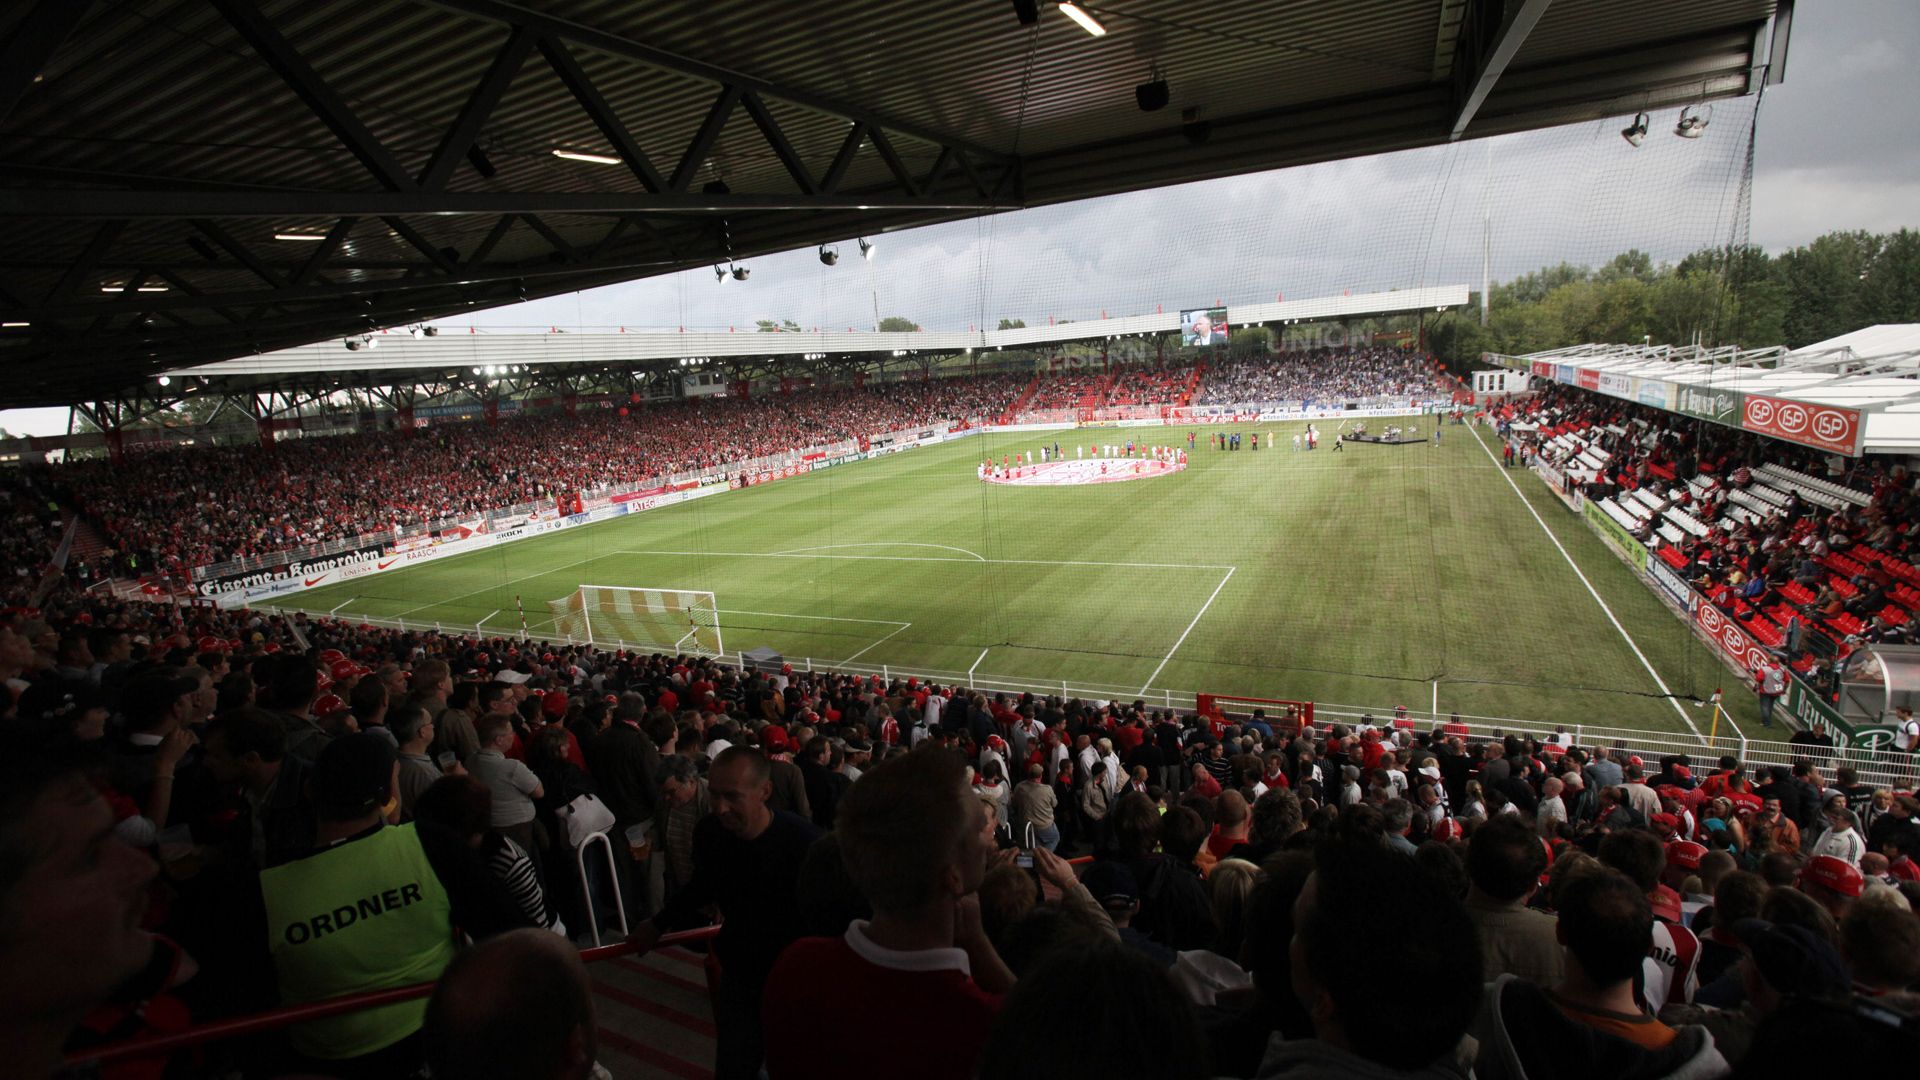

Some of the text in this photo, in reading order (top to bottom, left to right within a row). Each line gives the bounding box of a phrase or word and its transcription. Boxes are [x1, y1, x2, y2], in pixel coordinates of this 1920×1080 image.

[1267, 325, 1374, 353] UNION
[1048, 343, 1147, 371] EISERN
[1751, 403, 1770, 420] ISP
[1782, 409, 1804, 428] ISP
[1818, 415, 1844, 436] ISP
[501, 528, 523, 538] KOCH
[406, 548, 437, 561] RAASCH
[200, 572, 273, 597] Eiserne
[289, 549, 380, 578] Kameraden
[284, 882, 423, 945] ORDNER
